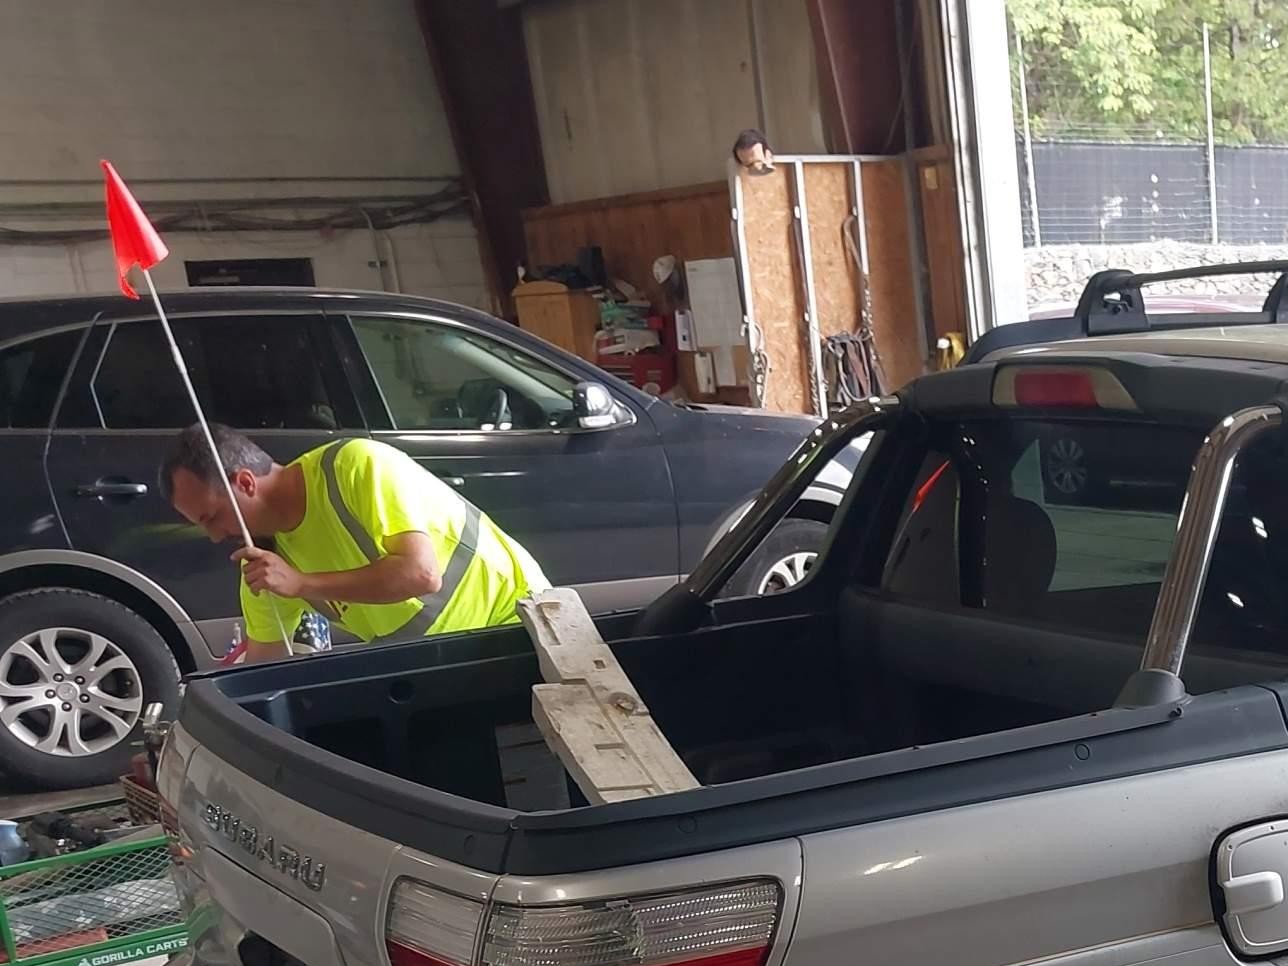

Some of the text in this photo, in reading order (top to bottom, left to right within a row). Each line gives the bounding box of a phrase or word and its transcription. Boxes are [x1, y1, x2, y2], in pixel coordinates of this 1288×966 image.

[204, 804, 326, 892] SUBARU
[92, 937, 188, 966] GORILLA CARTS
